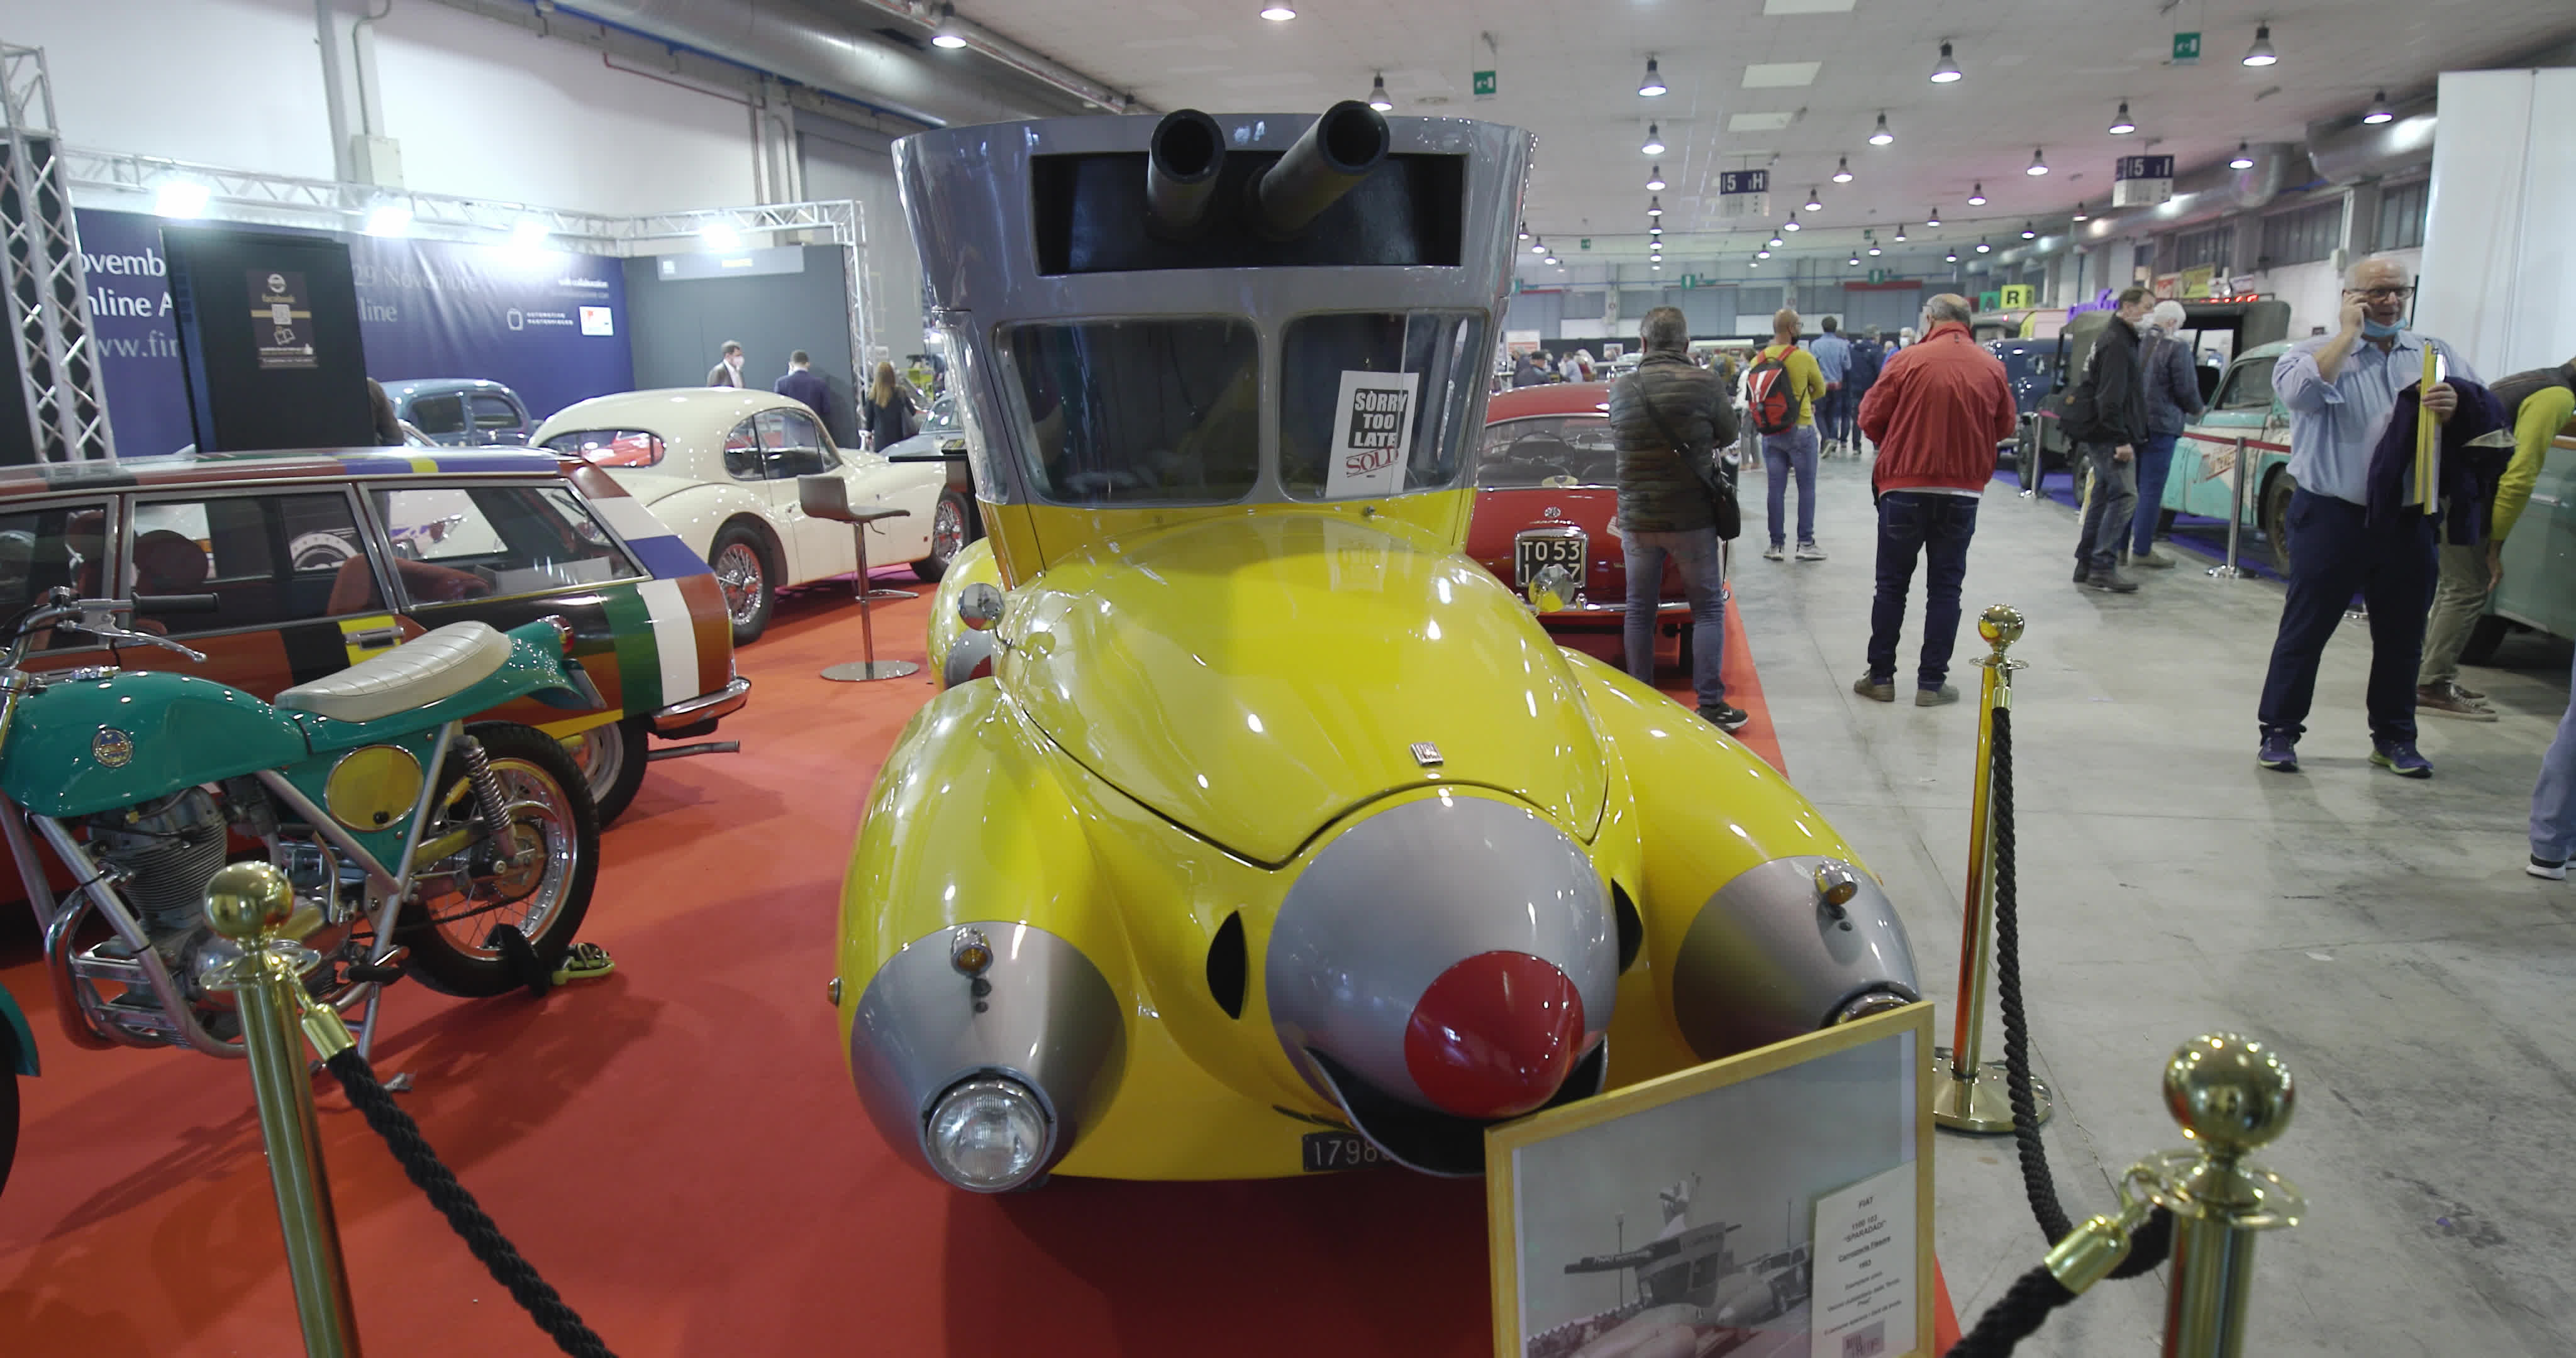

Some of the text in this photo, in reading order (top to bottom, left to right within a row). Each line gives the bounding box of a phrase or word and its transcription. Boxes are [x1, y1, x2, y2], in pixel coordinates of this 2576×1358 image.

[2007, 290, 2019, 304] R
[1354, 392, 1407, 412] SORRY
[1363, 413, 1395, 429] TOO
[1353, 431, 1397, 448] LATE
[1346, 444, 1399, 475] SOLD
[1554, 541, 1580, 561] 53
[1524, 564, 1580, 583] 17
[1314, 1139, 1391, 1166] 1798
[1858, 1196, 1874, 1209] FIAT
